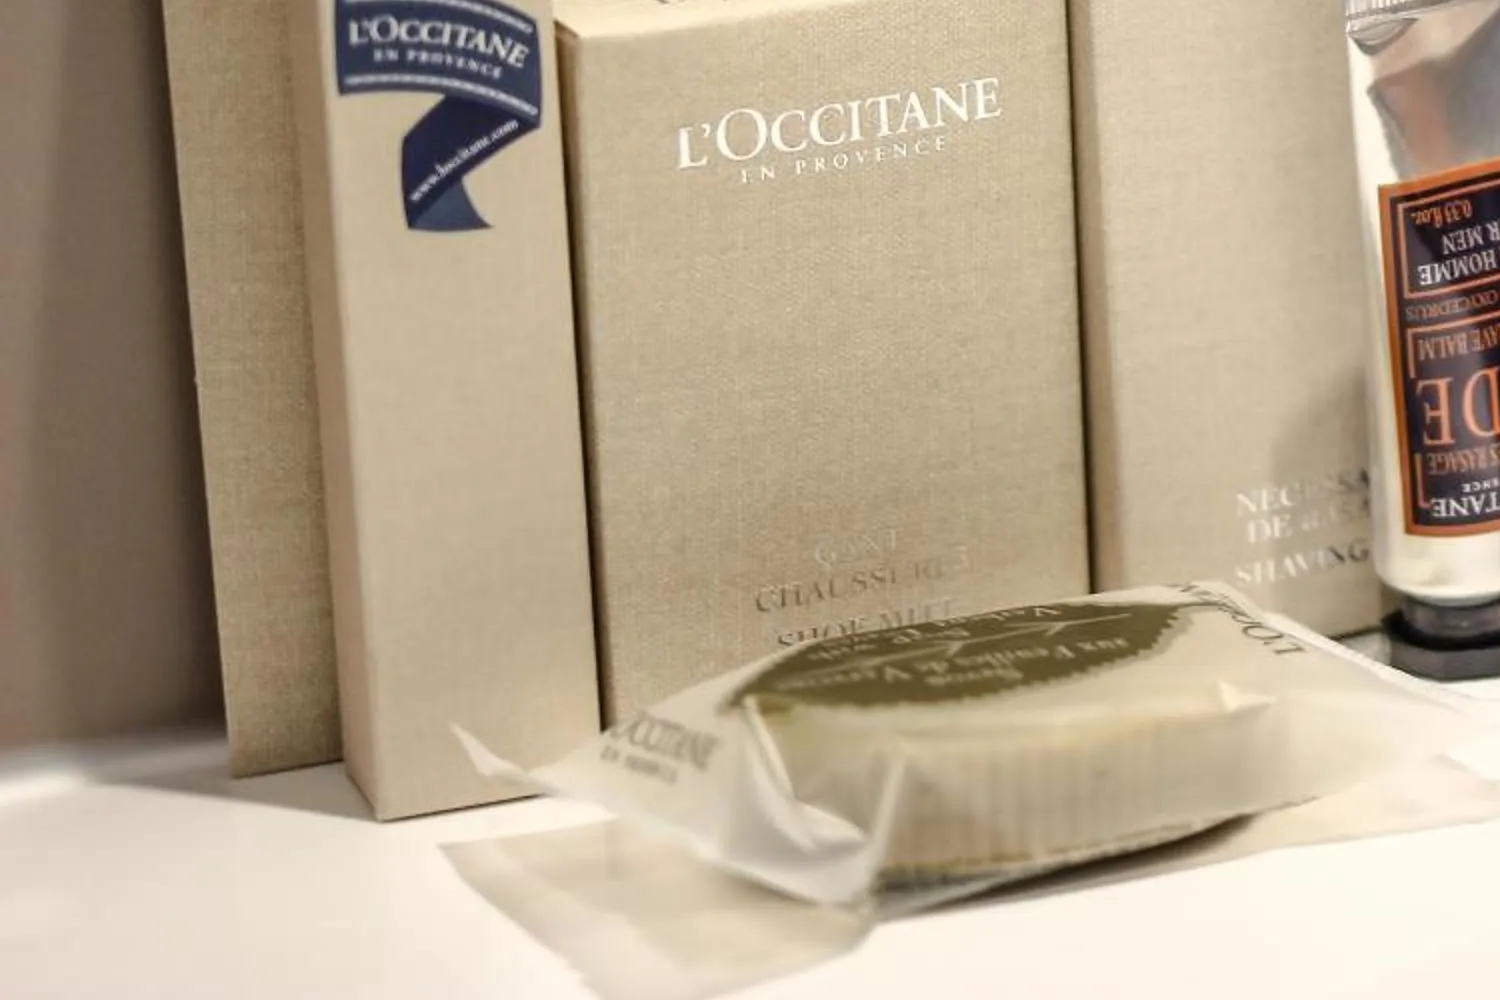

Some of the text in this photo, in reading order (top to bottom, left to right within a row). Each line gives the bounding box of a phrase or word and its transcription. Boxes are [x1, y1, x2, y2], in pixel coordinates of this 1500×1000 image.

[348, 13, 531, 68] L'OCCITANE
[373, 47, 503, 79] EN PROVENCE
[678, 77, 1002, 170] L'OCCITANE
[741, 135, 948, 184] EN PROVENCE
[1442, 224, 1485, 255] MEN
[1416, 249, 1498, 286] HOMME
[1418, 329, 1468, 360] BALM
[1246, 512, 1294, 545] DE
[1234, 537, 1372, 588] SHAVING
